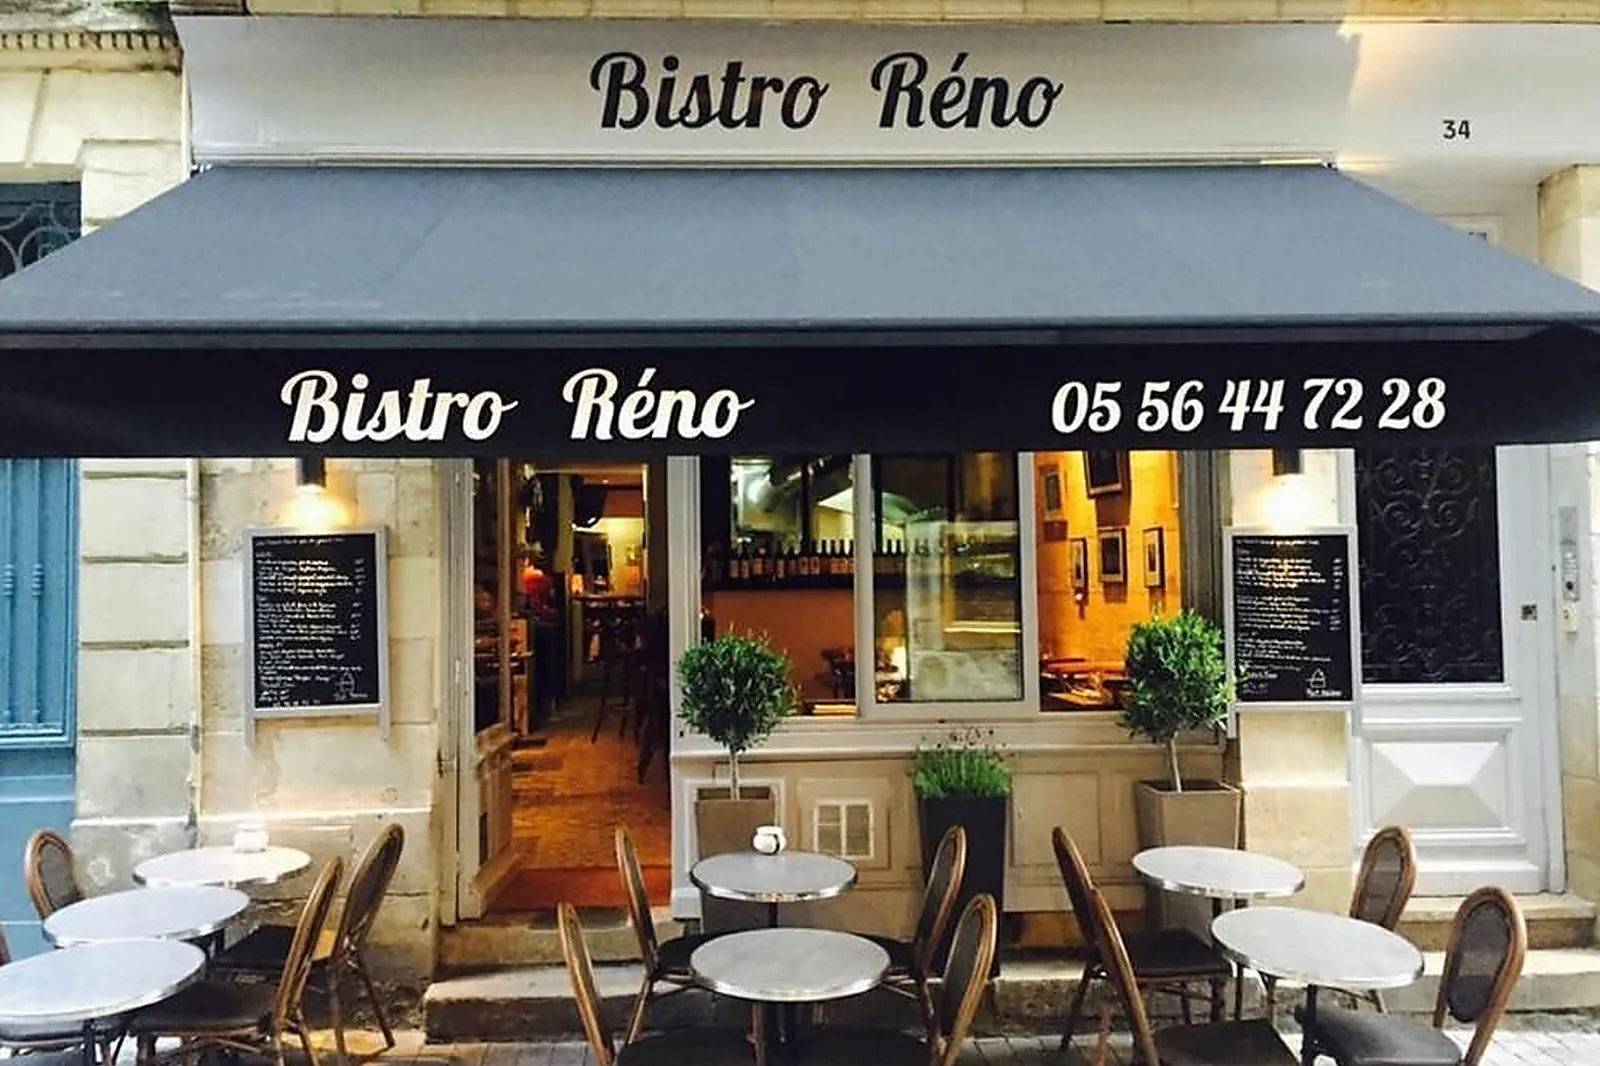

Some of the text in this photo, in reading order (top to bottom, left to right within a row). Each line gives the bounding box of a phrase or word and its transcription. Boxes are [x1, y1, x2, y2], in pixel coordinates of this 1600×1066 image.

[590, 51, 1064, 130] Bistro Réno
[1443, 120, 1471, 140] 34
[280, 367, 756, 443] Bistro Réno
[1051, 377, 1446, 434] 05 56 44 72 28
